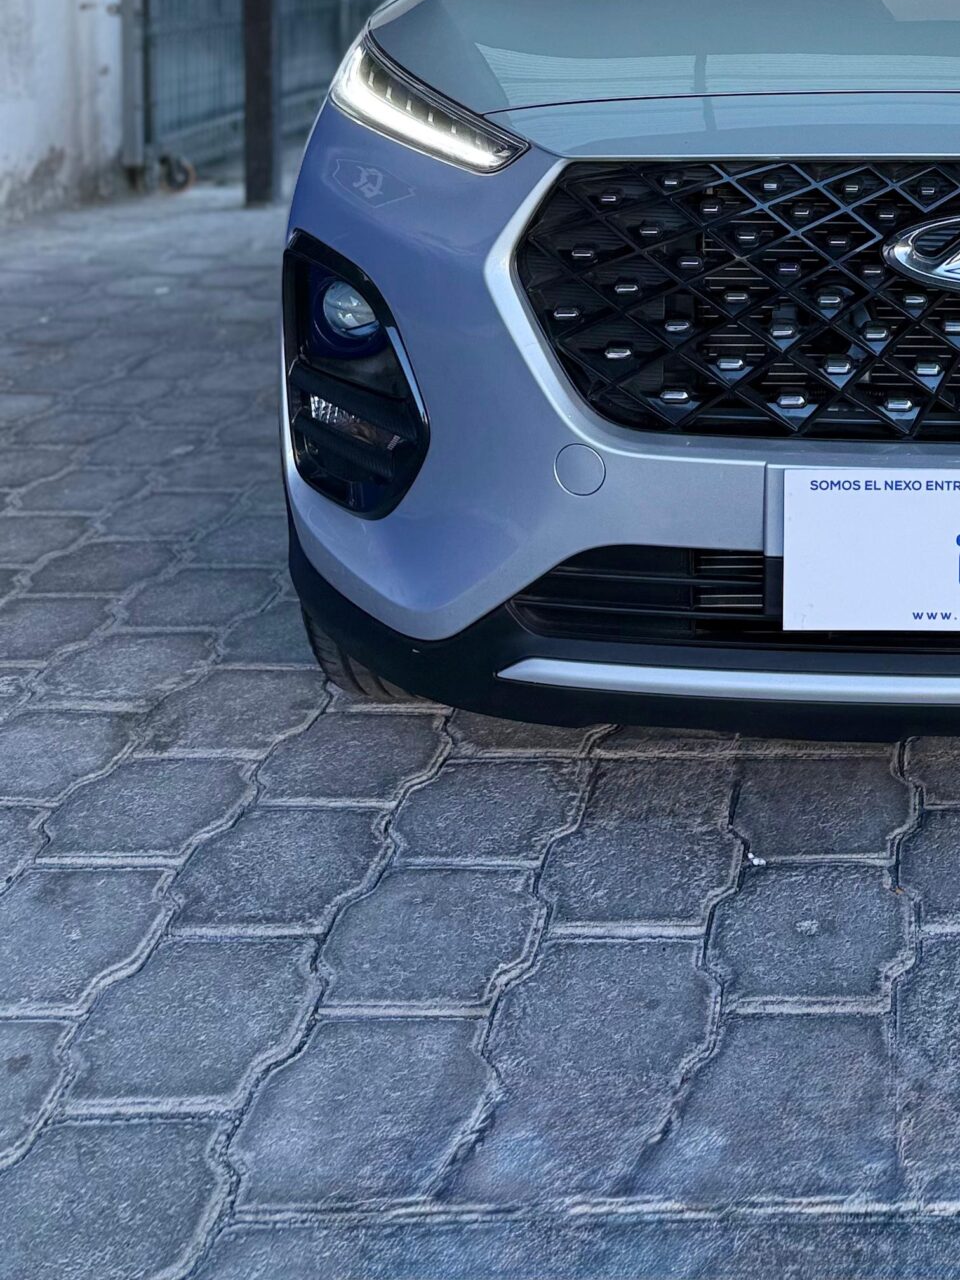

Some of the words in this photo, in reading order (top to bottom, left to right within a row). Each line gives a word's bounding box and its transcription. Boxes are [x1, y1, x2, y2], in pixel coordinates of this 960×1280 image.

[809, 479, 862, 491] SOMOS
[864, 480, 882, 491] EL
[884, 480, 923, 491] NEXO
